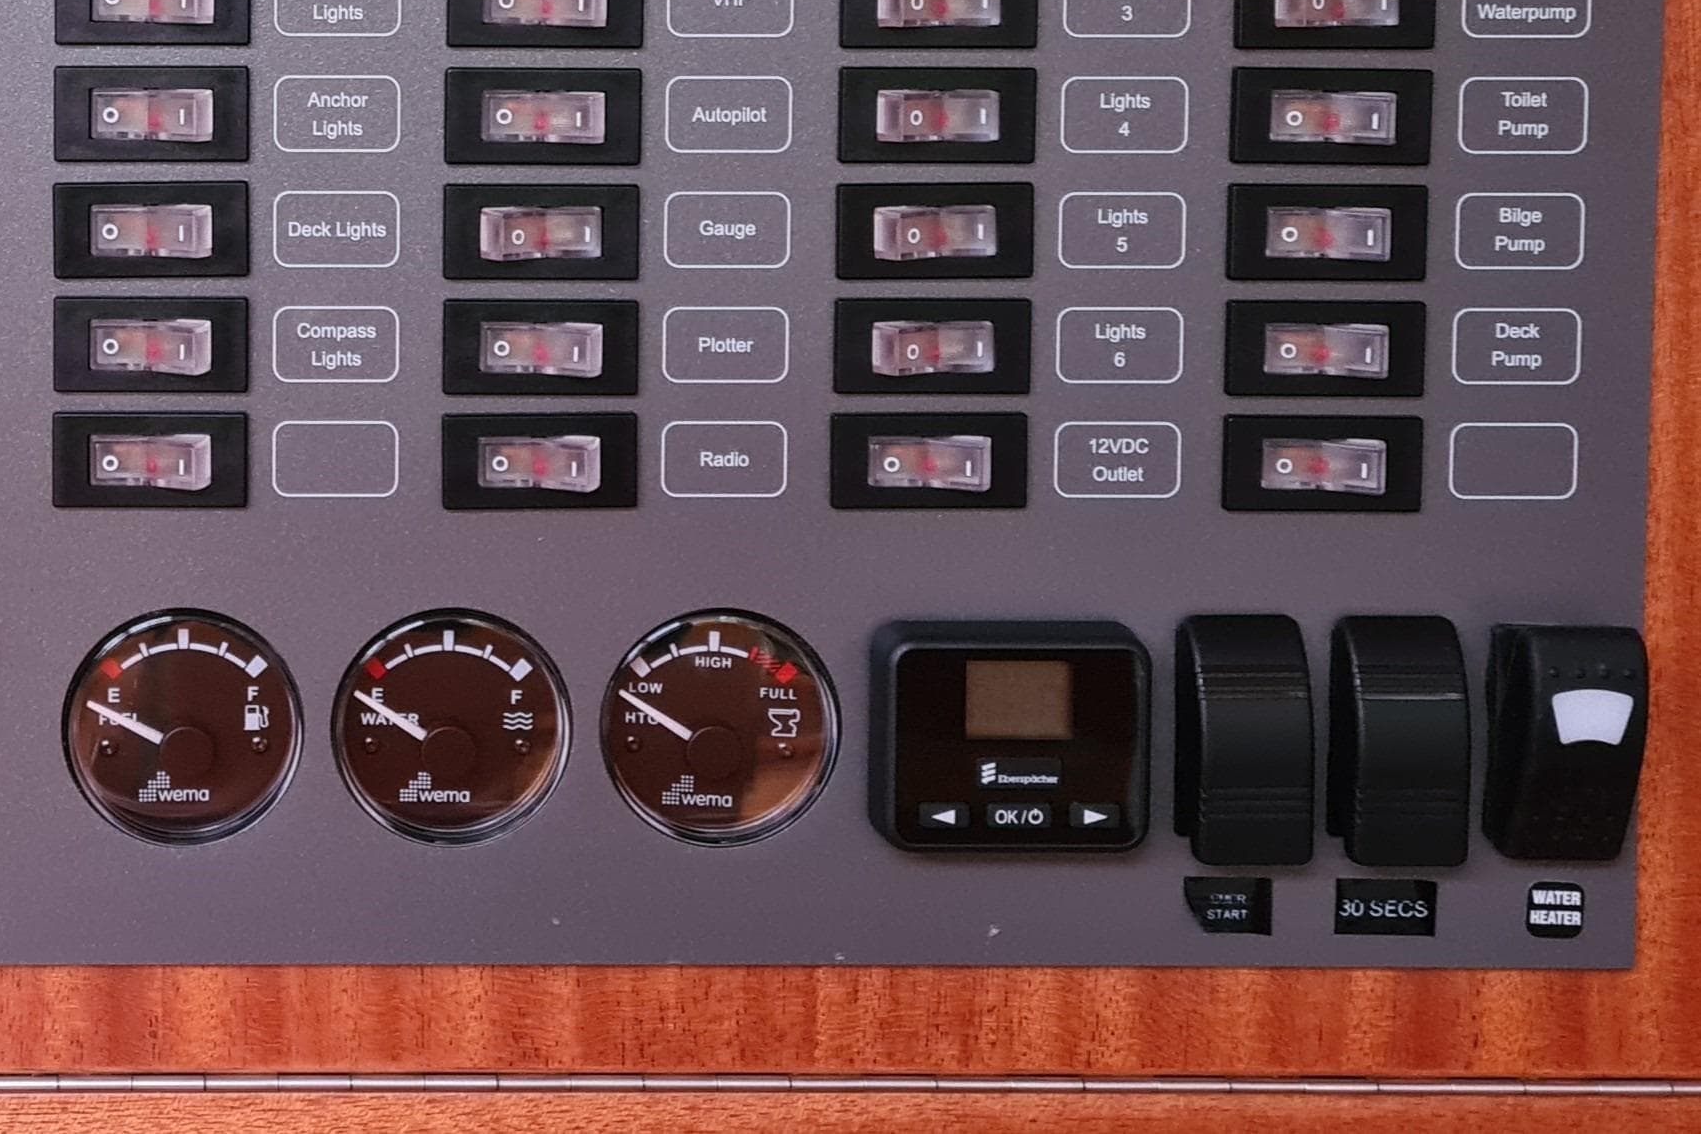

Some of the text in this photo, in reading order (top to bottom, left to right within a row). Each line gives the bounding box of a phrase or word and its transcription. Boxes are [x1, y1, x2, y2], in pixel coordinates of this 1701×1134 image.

[313, 5, 363, 22] Lights
[1121, 6, 1132, 21] 3
[1477, 4, 1576, 21] Waterpump
[308, 92, 368, 108] Anchor
[1100, 93, 1151, 111] Lights
[1501, 92, 1547, 108] Toilet
[692, 107, 767, 125] Autopilot
[313, 120, 363, 138] Lights
[1118, 122, 1130, 136] 4
[1499, 120, 1549, 139] Pump
[1098, 209, 1148, 227] Lights
[1499, 208, 1542, 226] Bilge
[288, 222, 387, 241] Deck Lights
[699, 221, 756, 238] Gauge
[1116, 237, 1128, 252] 5
[1495, 237, 1545, 254] Pump
[297, 323, 376, 341] Compass
[1095, 324, 1146, 342] Lights
[1496, 323, 1540, 339] Deck
[698, 337, 753, 353] Plotter
[311, 351, 362, 369] Lights
[1114, 352, 1126, 367] 6
[1491, 351, 1542, 370] Pump
[1089, 439, 1149, 454] 12VDC
[700, 451, 749, 467] Radio
[1092, 467, 1143, 482] Outlet
[695, 656, 732, 668] HIGH
[108, 688, 120, 702] E
[247, 686, 259, 701] F
[371, 688, 384, 702] E
[629, 682, 663, 694] LOW
[760, 687, 797, 700] FULL
[511, 690, 523, 704] F
[361, 713, 419, 725] WAR
[159, 789, 209, 801] wema
[419, 790, 470, 802] wema
[681, 792, 733, 807] wema
[1532, 890, 1581, 906] WATER
[1207, 909, 1247, 919] START
[1339, 900, 1428, 917] 30 SECS
[1530, 910, 1581, 926] HEATER
